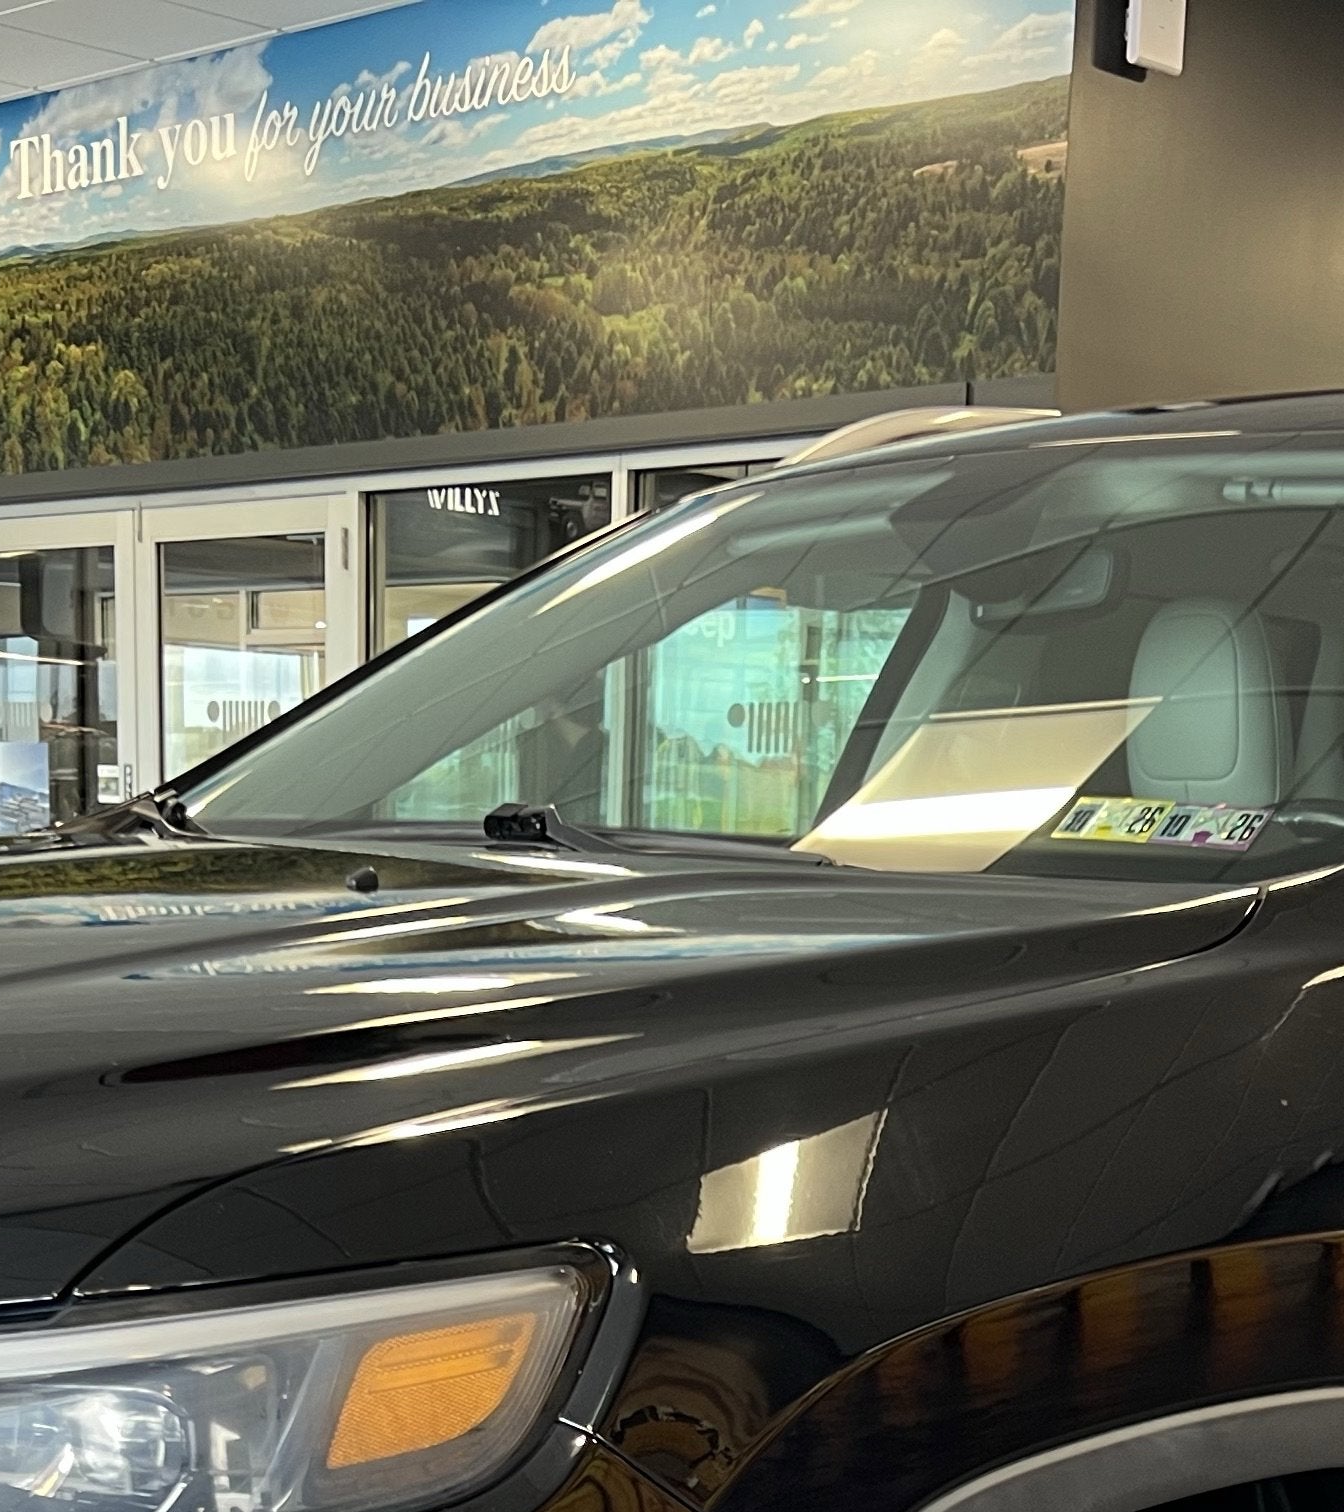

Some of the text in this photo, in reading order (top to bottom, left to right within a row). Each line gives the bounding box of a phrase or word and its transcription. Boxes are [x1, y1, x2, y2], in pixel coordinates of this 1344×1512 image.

[10, 43, 578, 200] Thank you for your business
[427, 487, 500, 516] WILLYS
